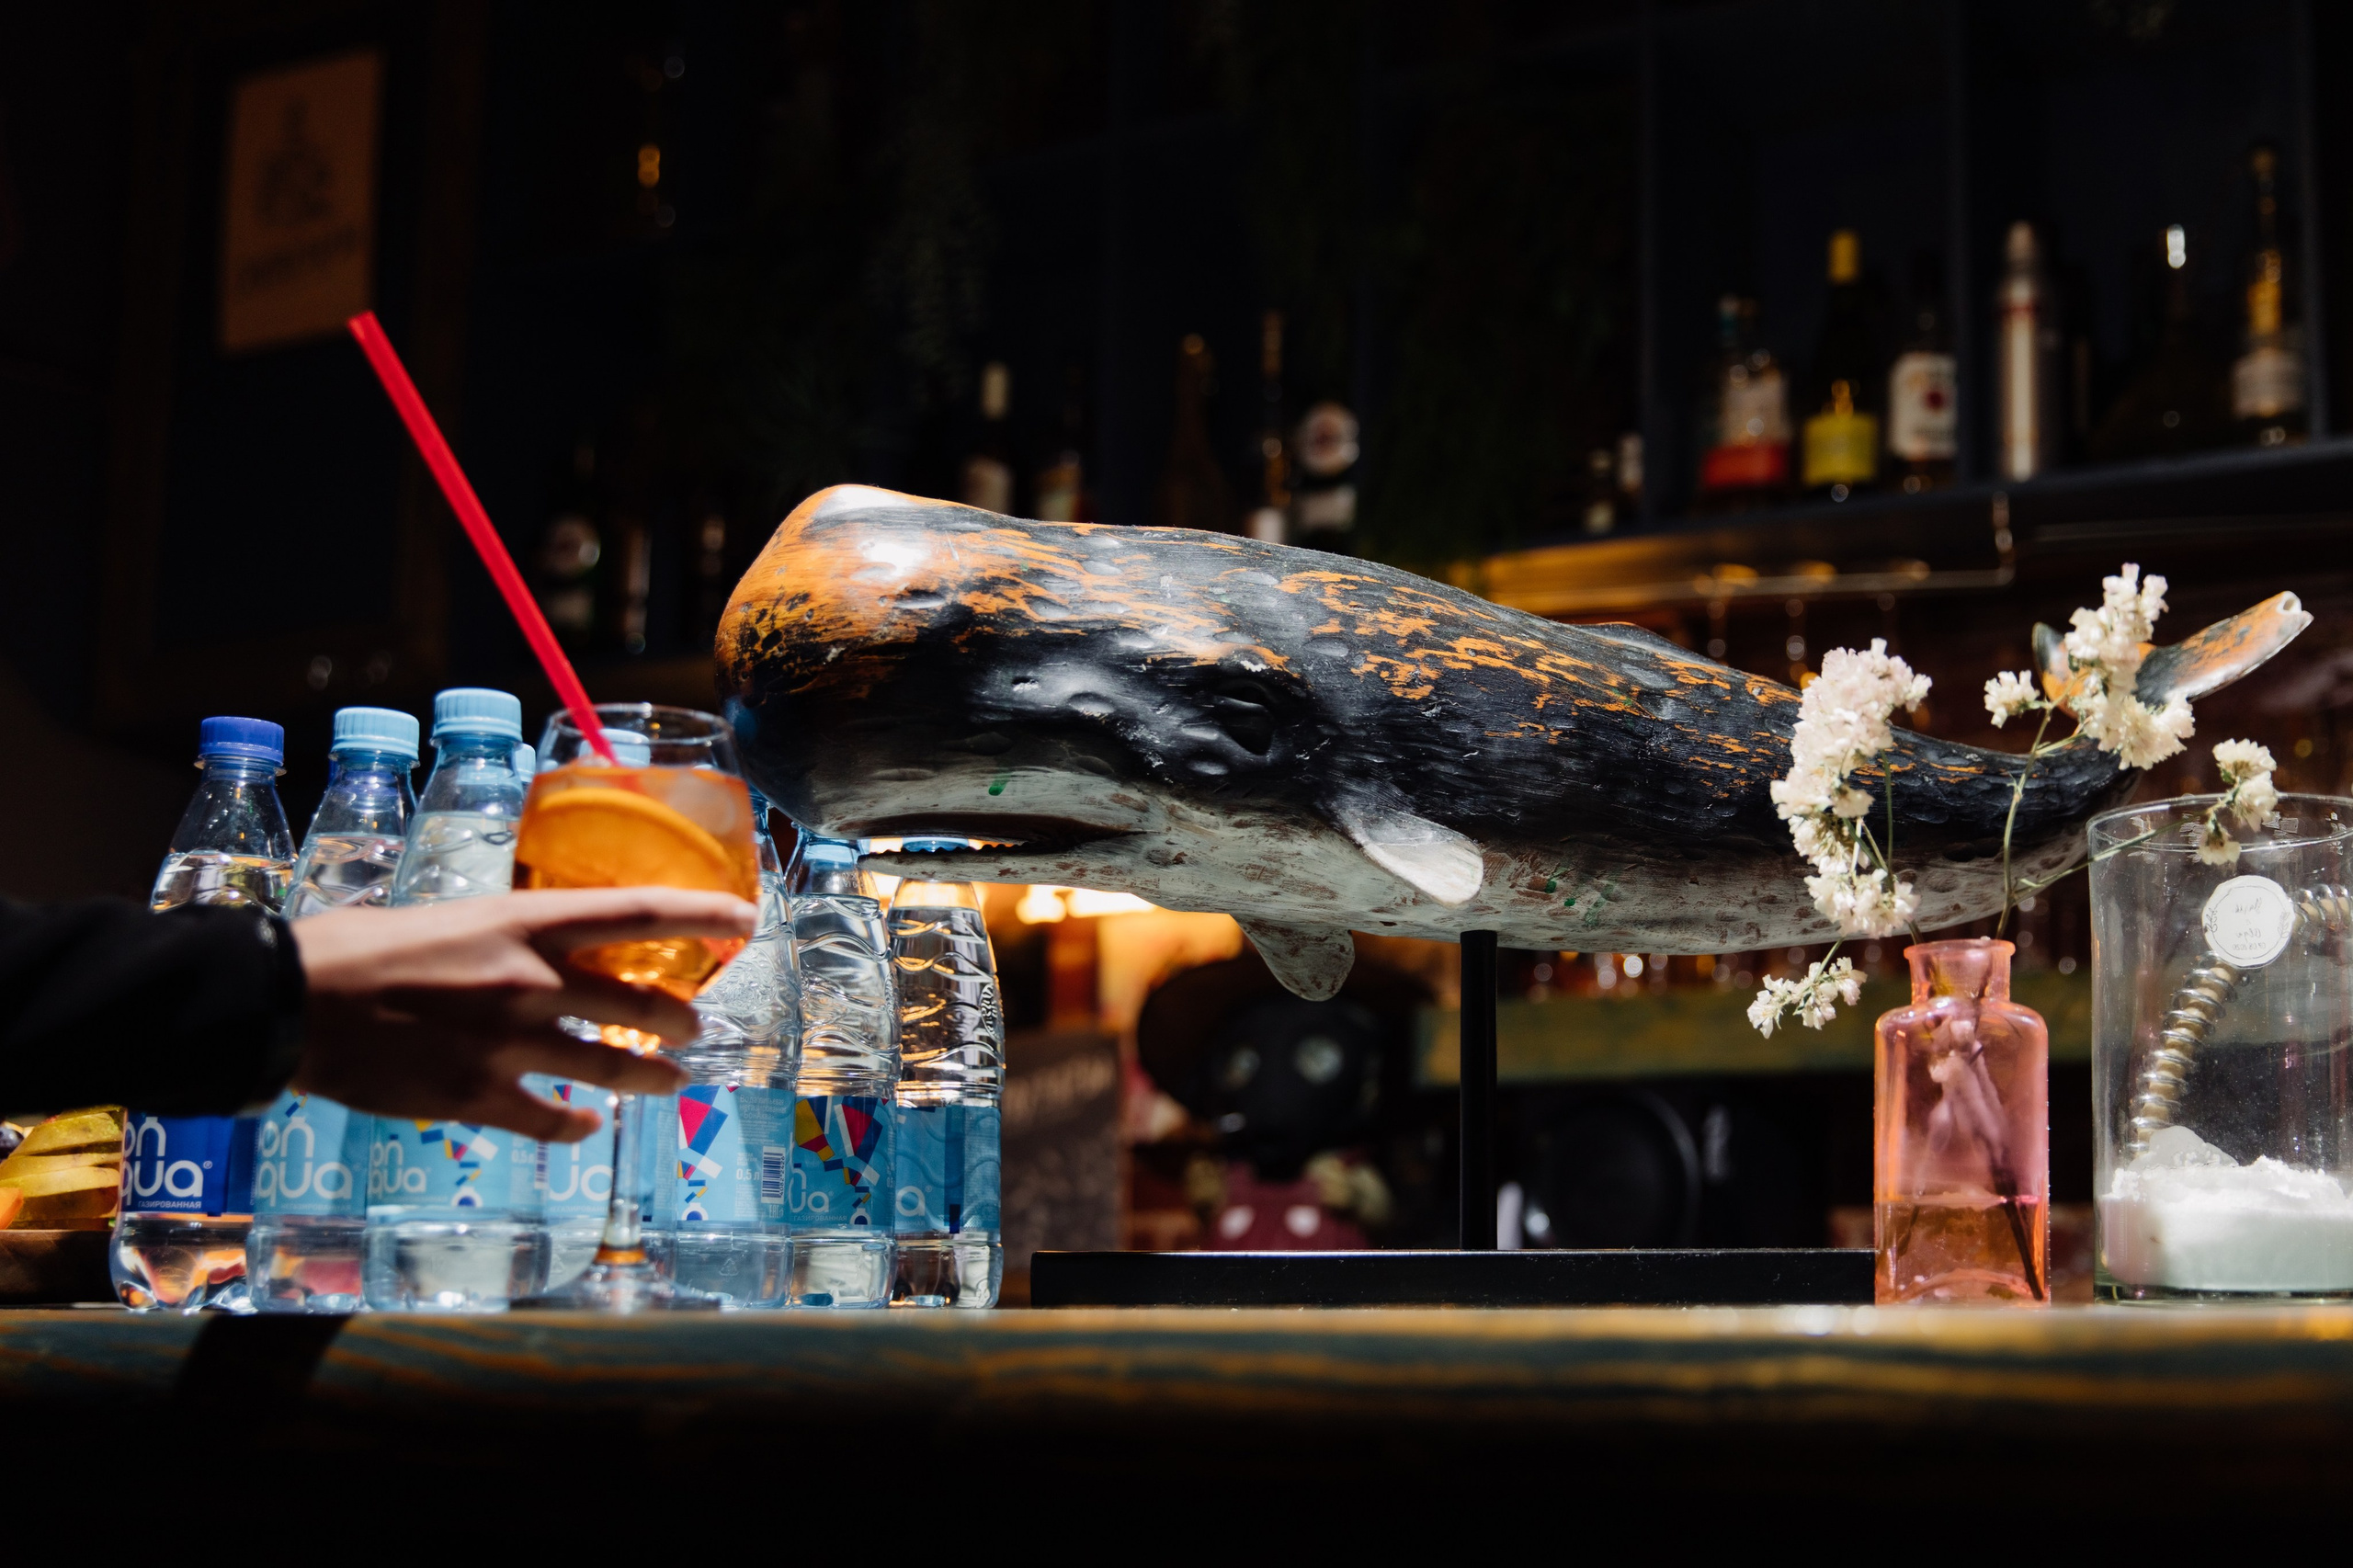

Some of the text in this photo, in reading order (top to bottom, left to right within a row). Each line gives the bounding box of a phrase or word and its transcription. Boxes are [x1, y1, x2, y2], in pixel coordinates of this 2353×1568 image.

[736, 1168, 752, 1181] 0,5
[256, 1160, 353, 1207] qua
[138, 1199, 202, 1209] ГАЗИРОВАННАЯ
